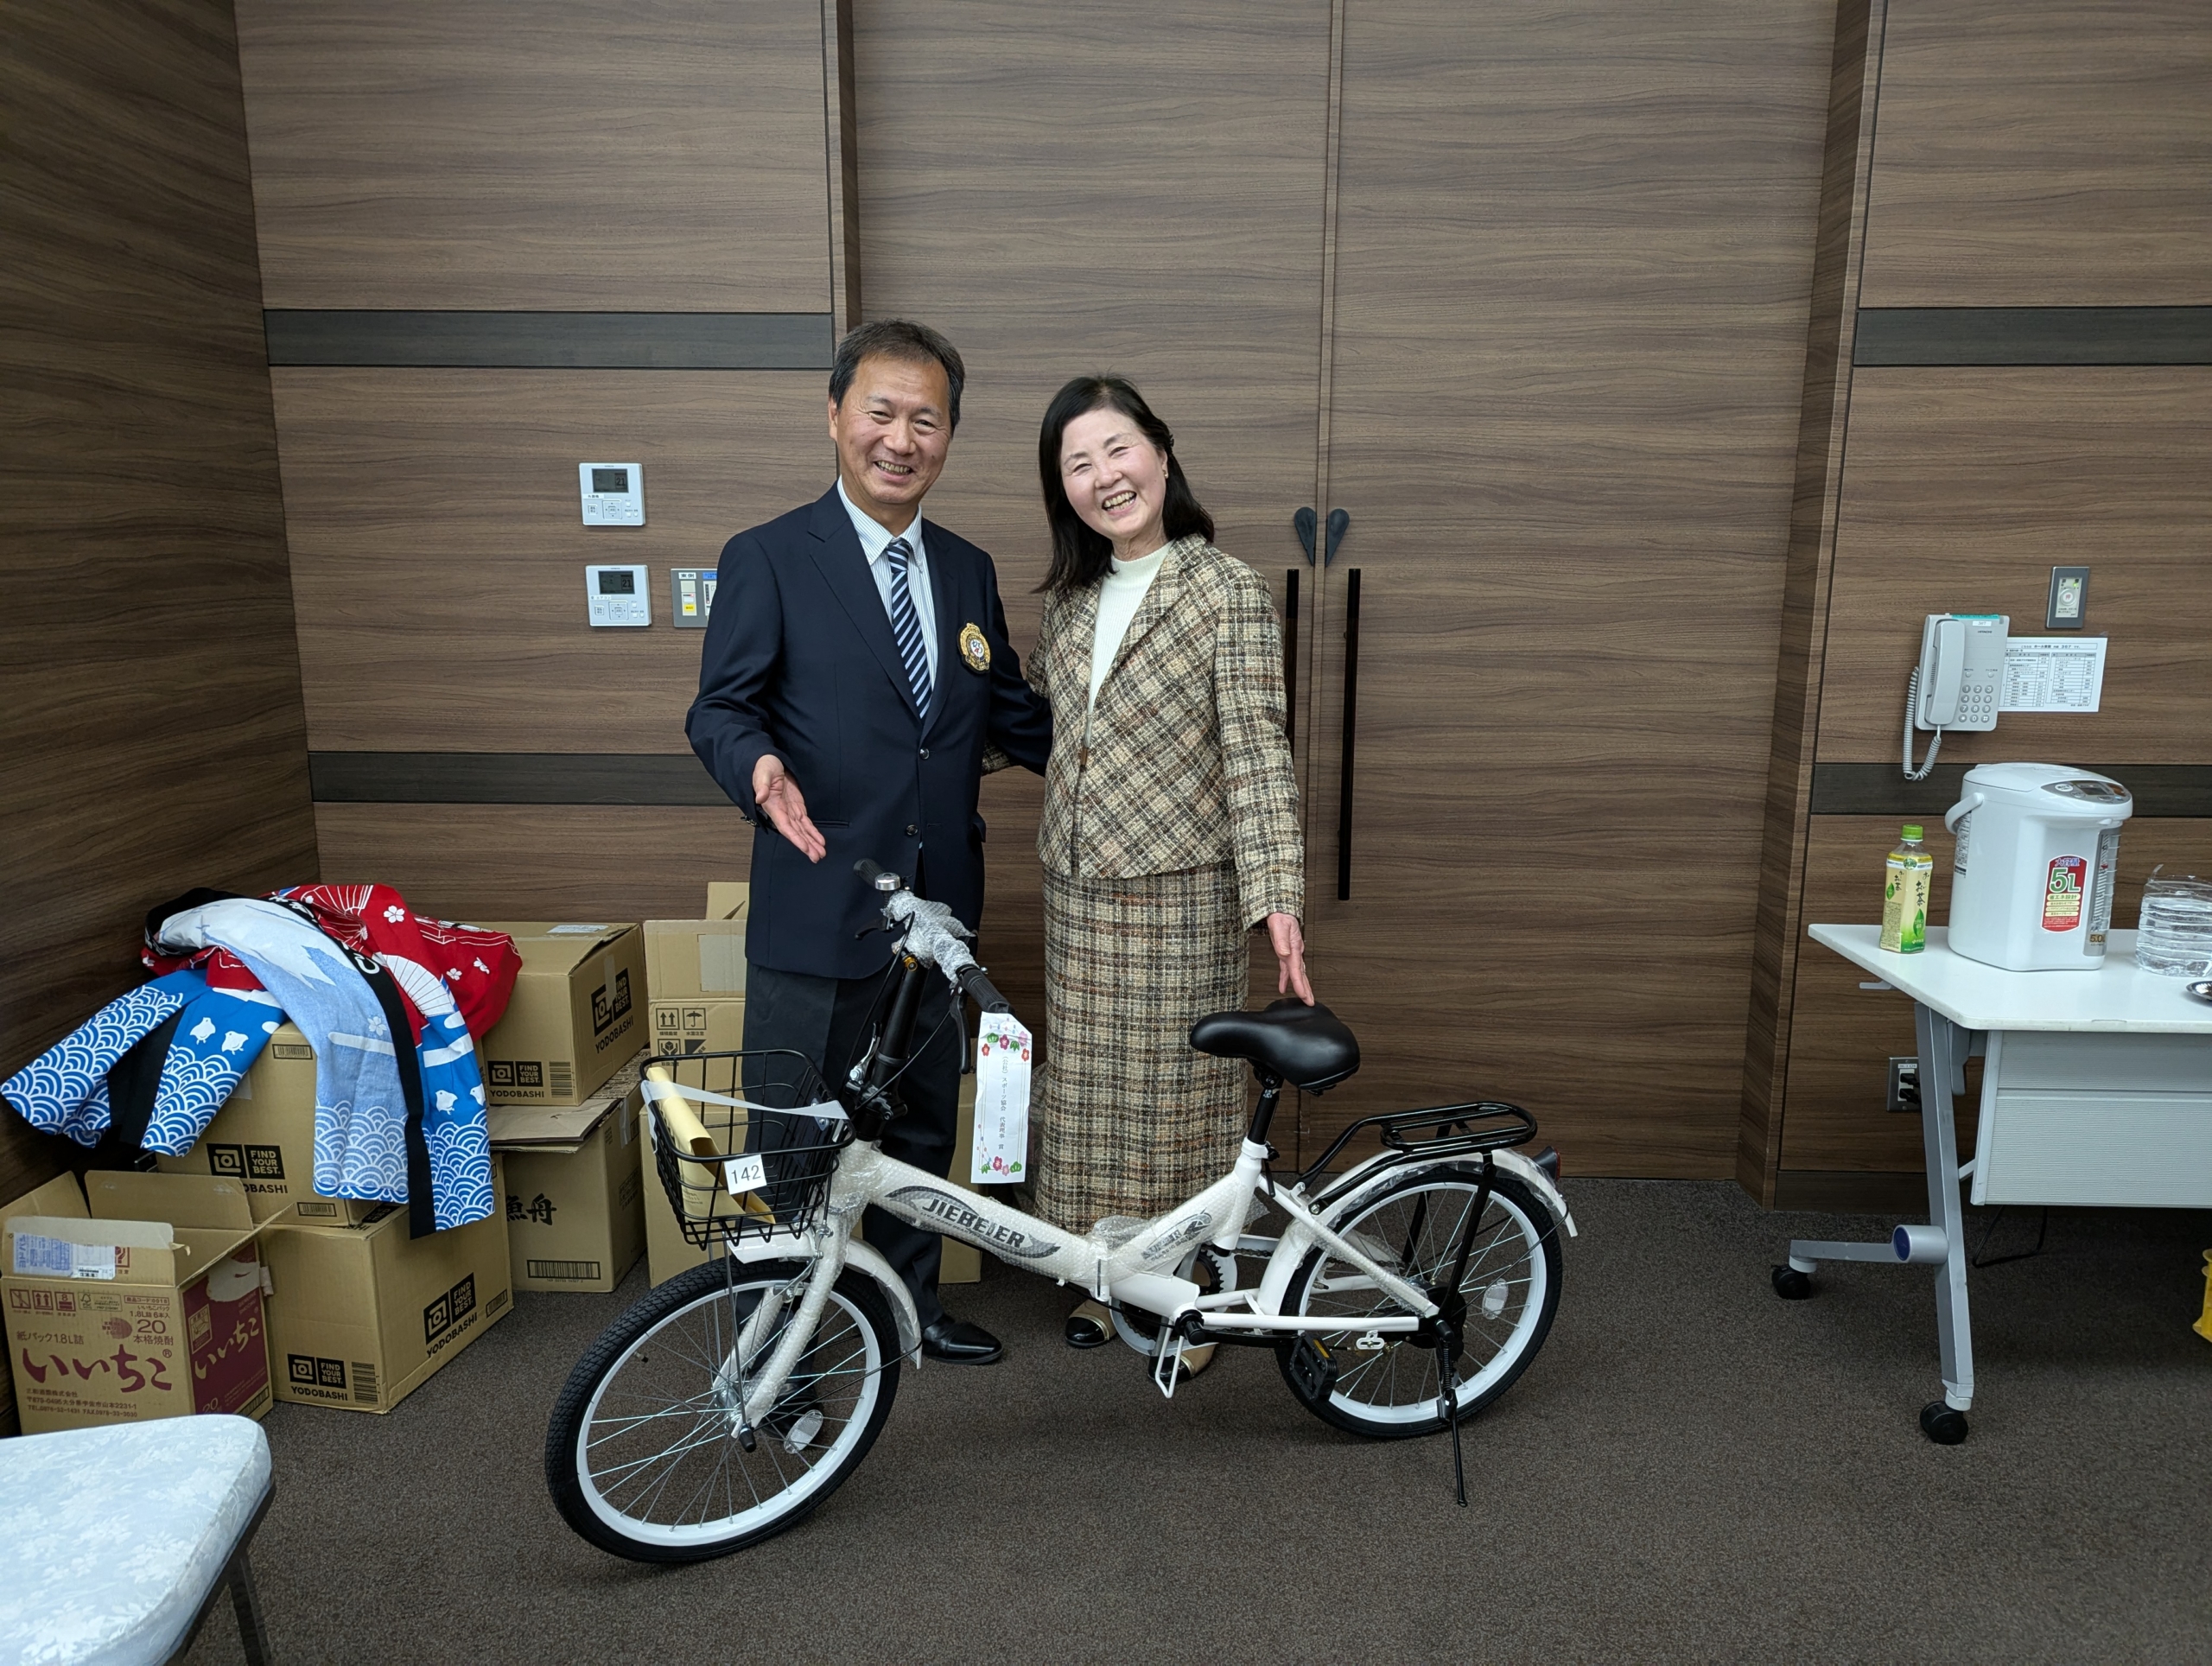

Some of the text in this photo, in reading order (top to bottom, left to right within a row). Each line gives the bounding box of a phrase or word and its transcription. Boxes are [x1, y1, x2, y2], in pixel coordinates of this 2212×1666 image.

[615, 477, 626, 486] 21
[622, 579, 632, 588] 21
[2049, 868, 2081, 893] 5L
[1916, 880, 1925, 906] お茶
[616, 976, 626, 991] IND
[595, 1015, 634, 1054] YODOBASHI
[998, 1116, 1007, 1139] 代表理事
[251, 1150, 276, 1159] FIND
[251, 1158, 277, 1167] YOUR
[253, 1166, 282, 1174] BEST.
[731, 1165, 761, 1185] 142
[244, 1184, 289, 1194] OBASHI
[922, 1198, 1026, 1249] JIEBEIER
[454, 1281, 472, 1300] FIND
[454, 1290, 472, 1306] YOUR
[454, 1298, 474, 1316] BEST.
[137, 1319, 166, 1334] 20
[16, 1331, 85, 1345] 紙パック1.8L詰
[133, 1334, 174, 1346] 本格焼酎
[426, 1312, 478, 1358] YODOBASHI
[194, 1317, 259, 1379] いいちこ
[22, 1344, 173, 1393] いいちこ
[321, 1362, 340, 1370] FIND
[321, 1376, 344, 1385] BEST.
[290, 1386, 348, 1402] YODOBASHI
